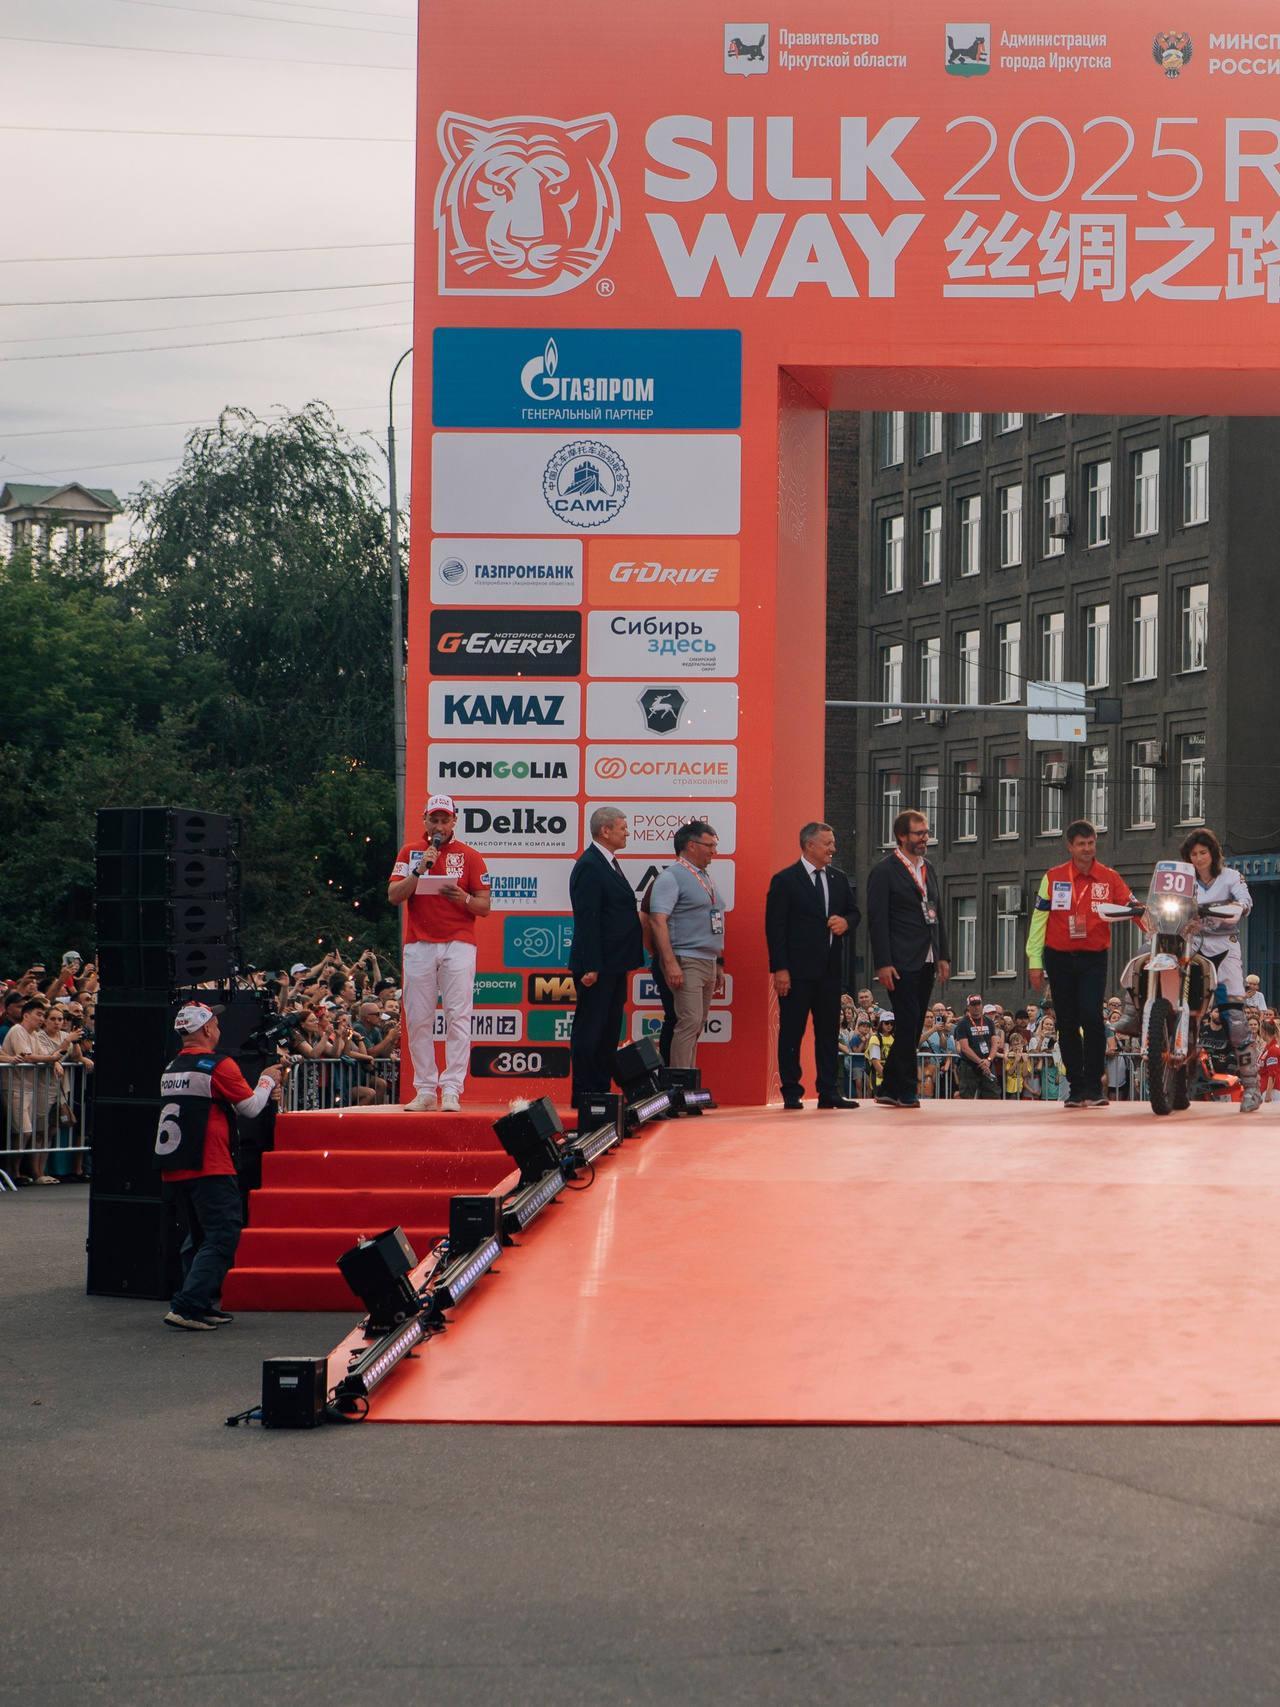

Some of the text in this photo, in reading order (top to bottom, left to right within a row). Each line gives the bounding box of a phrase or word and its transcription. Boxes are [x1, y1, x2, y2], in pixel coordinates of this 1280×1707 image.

[779, 28, 879, 49] Правительство
[1000, 30, 1107, 50] Администрация
[779, 51, 907, 71] Иркутской области
[1000, 52, 1112, 73] города Иркутска
[644, 115, 926, 203] SILK
[943, 115, 1204, 203] 2025
[644, 213, 926, 298] WAY
[561, 378, 654, 402] ГАЗПРОМ
[521, 406, 654, 421] ГЕНЕРАЛЬНЫЙ ПАРТНЕР
[554, 499, 618, 512] CAMF
[474, 564, 574, 579] ГАЗПРОМБАНК
[610, 616, 703, 639] Сибирь
[647, 639, 717, 656] здесь
[444, 694, 565, 725] KAMAZ
[439, 761, 568, 779] MONGOLIA
[629, 761, 729, 776] СОГЛАСИЕ
[672, 778, 729, 786] страхование
[463, 808, 567, 834] Delko
[490, 876, 538, 889] ГАЗПРОМ
[1162, 872, 1186, 892] 30
[490, 890, 537, 898] ДОБЫЧА
[473, 981, 517, 989] НОВОСТИ
[497, 1052, 542, 1072] 360
[161, 1078, 190, 1090] PODIUM
[154, 1102, 182, 1156] 6
